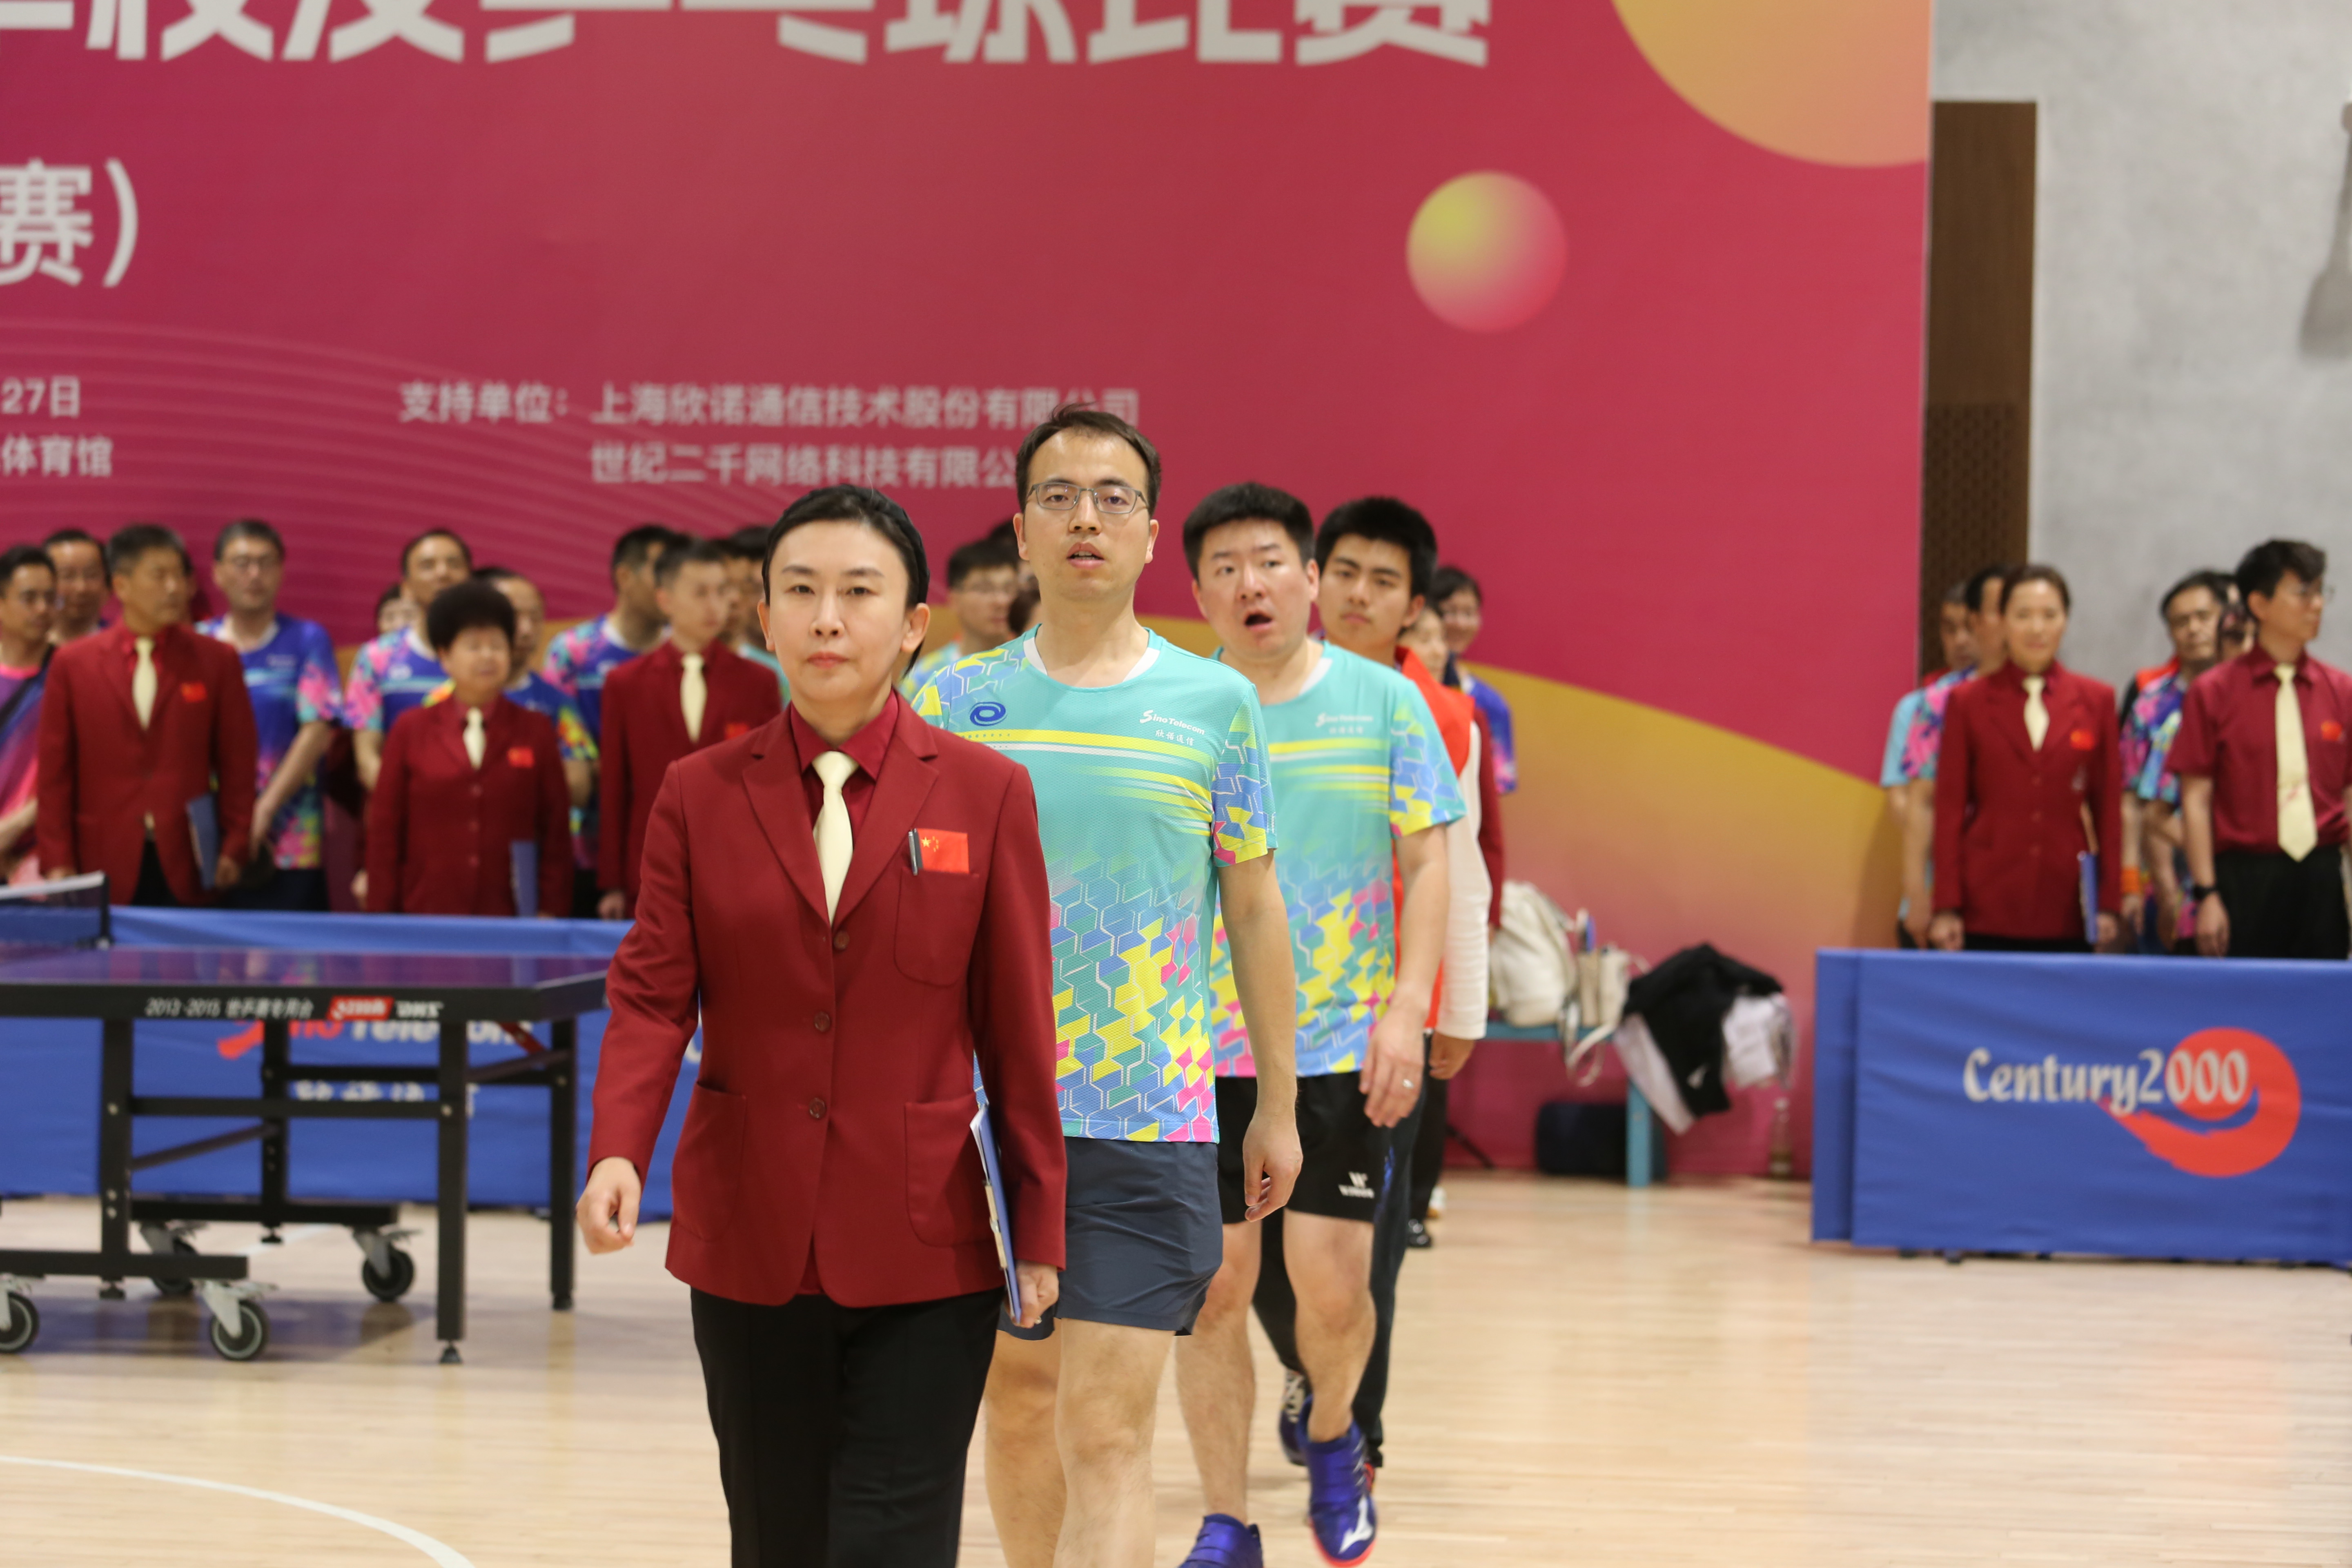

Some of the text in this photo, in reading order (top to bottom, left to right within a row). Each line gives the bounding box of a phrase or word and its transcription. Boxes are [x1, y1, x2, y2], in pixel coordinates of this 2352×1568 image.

[399, 381, 569, 424] 支持单位：
[1155, 729, 1194, 746] 欣诺通信
[1962, 1046, 2248, 1117] Century2000
